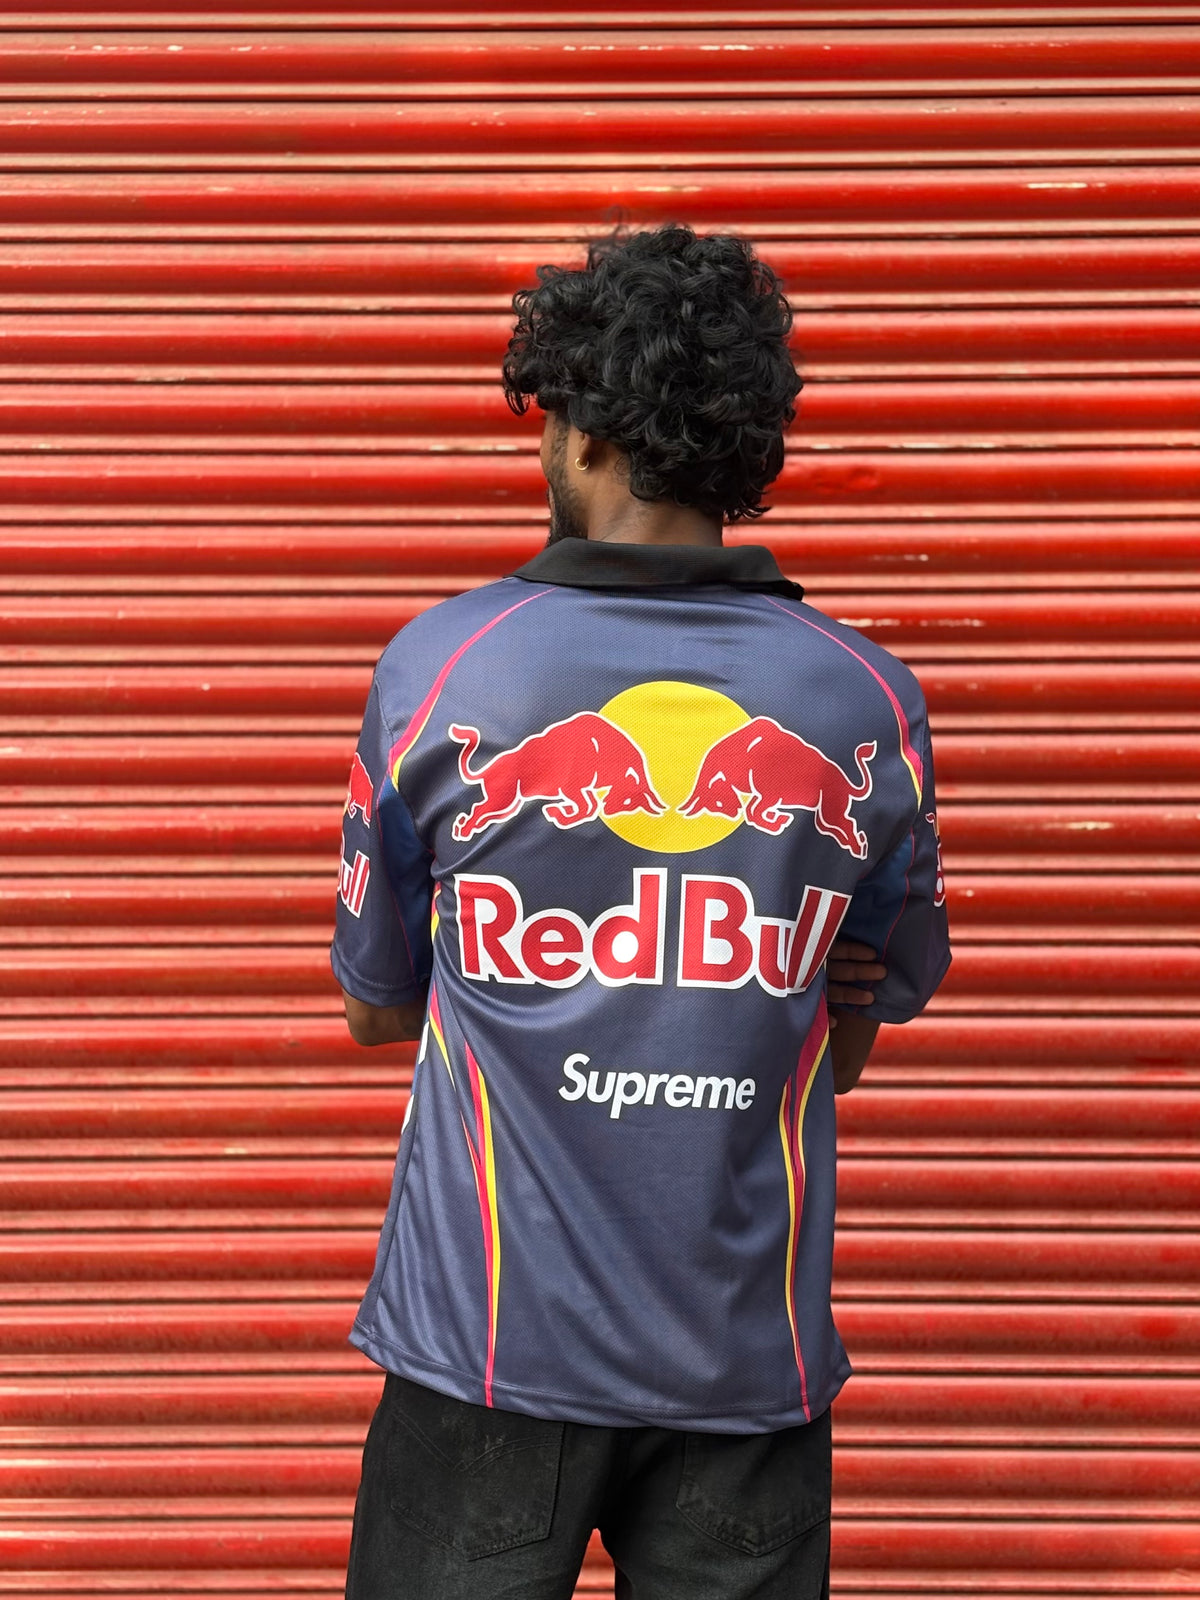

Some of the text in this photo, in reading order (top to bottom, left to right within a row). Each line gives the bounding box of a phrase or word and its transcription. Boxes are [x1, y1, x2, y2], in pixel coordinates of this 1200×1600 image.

[337, 838, 371, 918] ull
[453, 867, 668, 989] Red
[676, 873, 853, 998] Bull
[558, 1052, 756, 1120] Supreme
